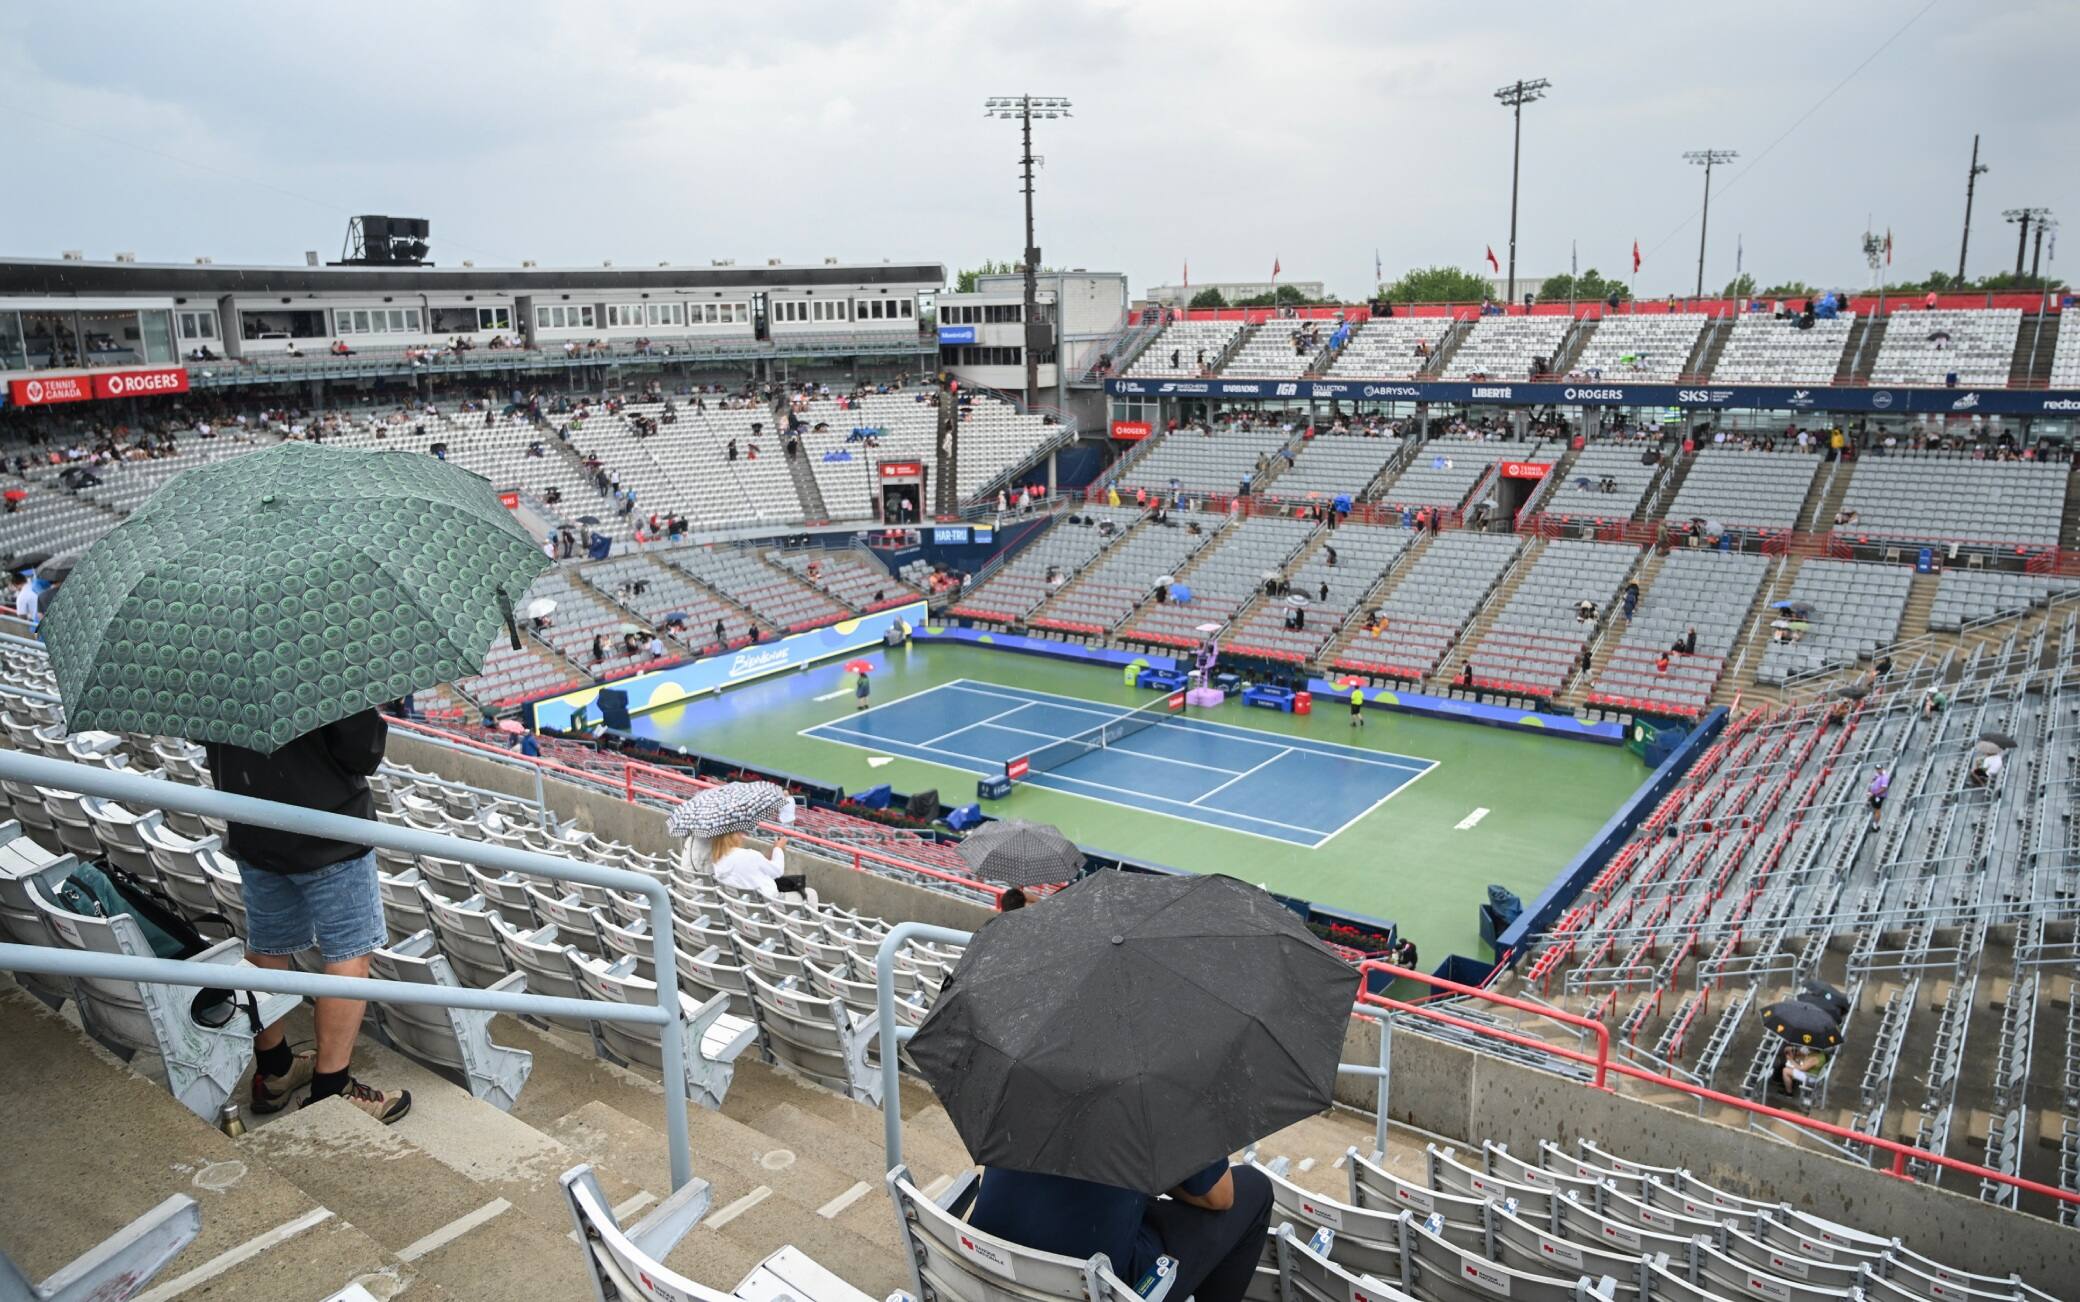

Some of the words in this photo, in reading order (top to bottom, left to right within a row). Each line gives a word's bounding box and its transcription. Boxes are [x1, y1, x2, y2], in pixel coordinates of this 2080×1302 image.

[44, 379, 76, 389] TENNIS
[126, 374, 178, 391] ROGERS
[45, 388, 81, 399] CANADA
[1276, 383, 1297, 395] IGA
[1373, 387, 1415, 396] ABRYSVO
[1578, 389, 1623, 400] ROGERS
[1679, 390, 1708, 402] SKS
[1122, 427, 1147, 435] ROGERS
[935, 529, 967, 541] HAR-TRU
